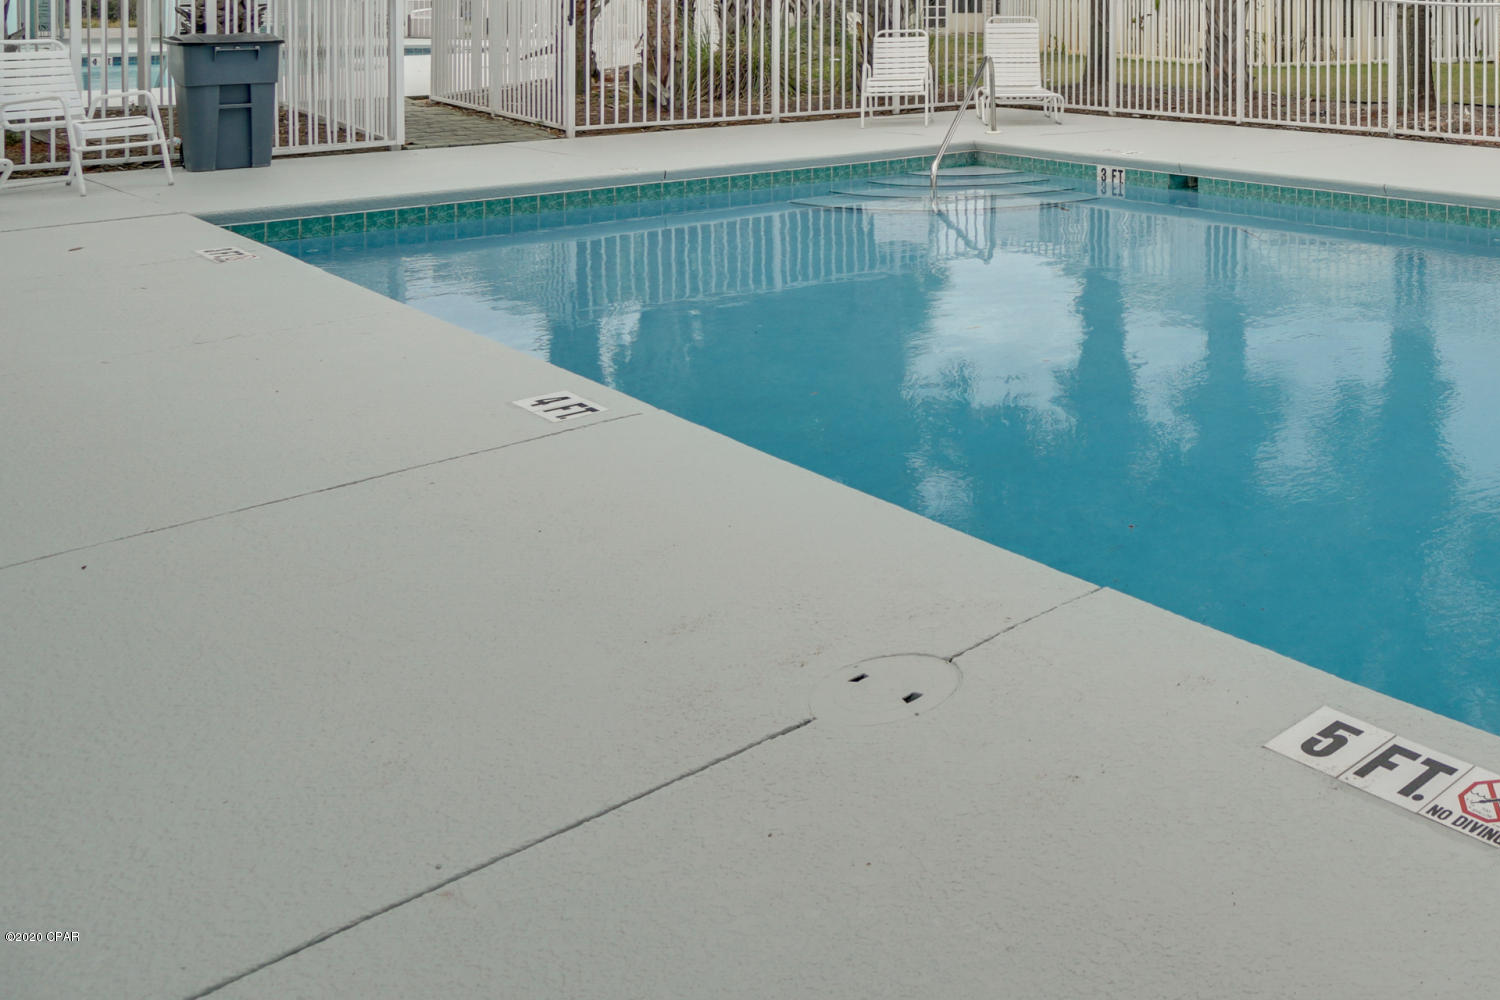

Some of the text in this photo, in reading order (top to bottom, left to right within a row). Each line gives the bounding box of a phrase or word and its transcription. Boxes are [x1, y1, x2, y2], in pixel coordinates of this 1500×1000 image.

[1100, 167, 1107, 182] 3
[531, 396, 571, 407] 4
[1300, 719, 1458, 801] 5 FT.
[1426, 804, 1453, 821] NO
